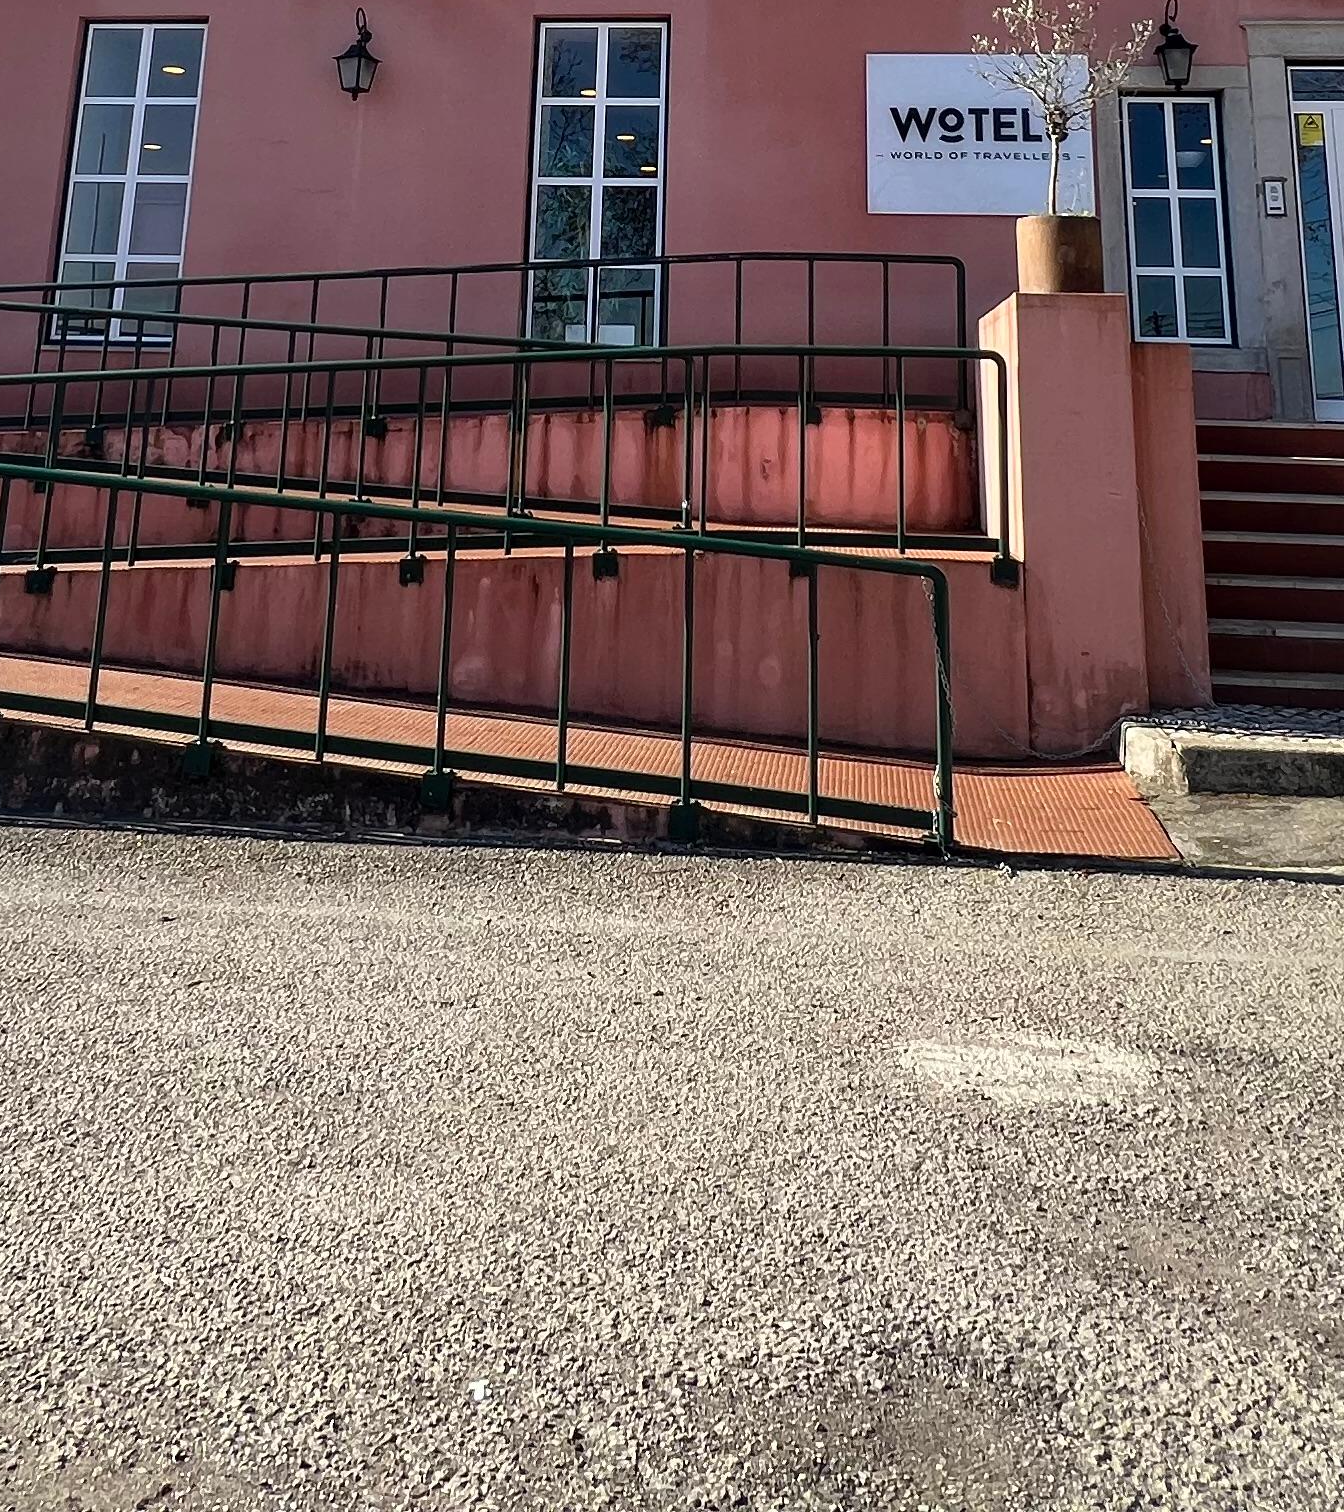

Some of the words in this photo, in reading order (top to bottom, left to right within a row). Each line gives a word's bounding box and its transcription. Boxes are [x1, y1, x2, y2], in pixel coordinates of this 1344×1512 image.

[890, 152, 943, 160] WORLD
[948, 152, 967, 160] OF
[975, 152, 1071, 161] TRAVELLES
